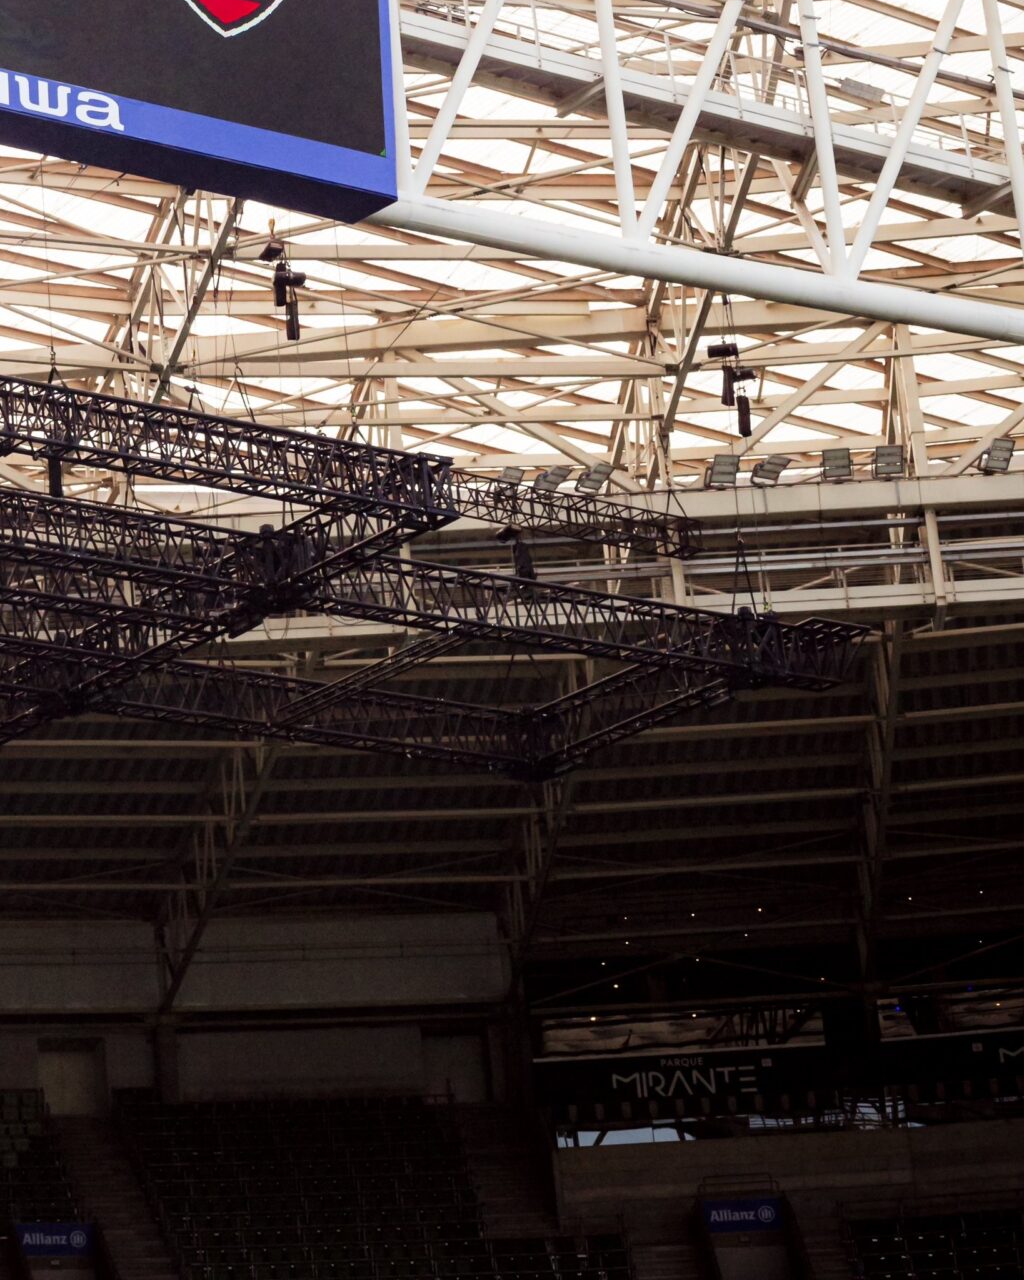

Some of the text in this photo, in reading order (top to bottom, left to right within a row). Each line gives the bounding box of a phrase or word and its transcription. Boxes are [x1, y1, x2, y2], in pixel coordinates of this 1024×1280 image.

[659, 1056, 704, 1068] PARQUE
[611, 1065, 758, 1099] MIRANTE
[710, 1208, 756, 1223] Allianz
[22, 1232, 68, 1246] Allianz
